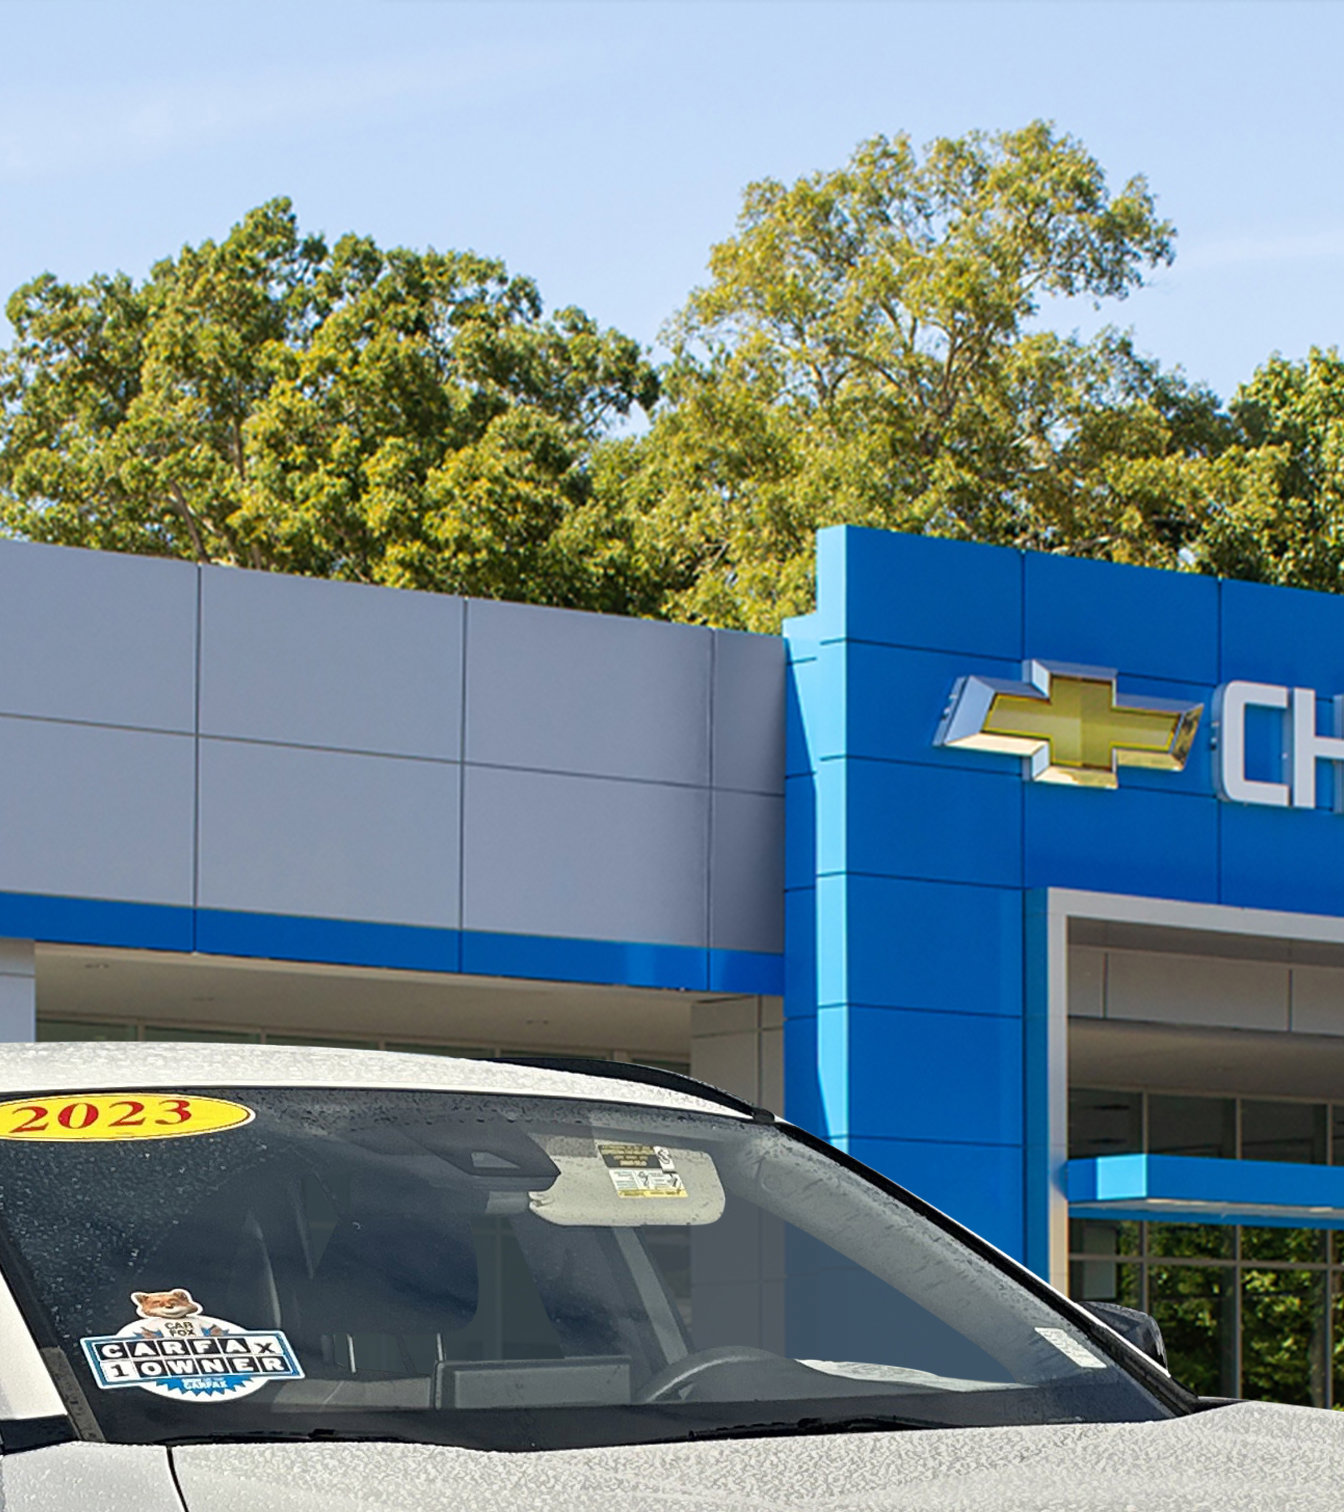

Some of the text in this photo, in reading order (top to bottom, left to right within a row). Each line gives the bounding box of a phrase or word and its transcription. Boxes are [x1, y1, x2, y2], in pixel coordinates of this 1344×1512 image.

[9, 1099, 193, 1134] 2023
[164, 1321, 194, 1330] CAR
[168, 1329, 197, 1337] FOX
[100, 1337, 278, 1358] CARFAX
[109, 1356, 285, 1378] 1 OWNER
